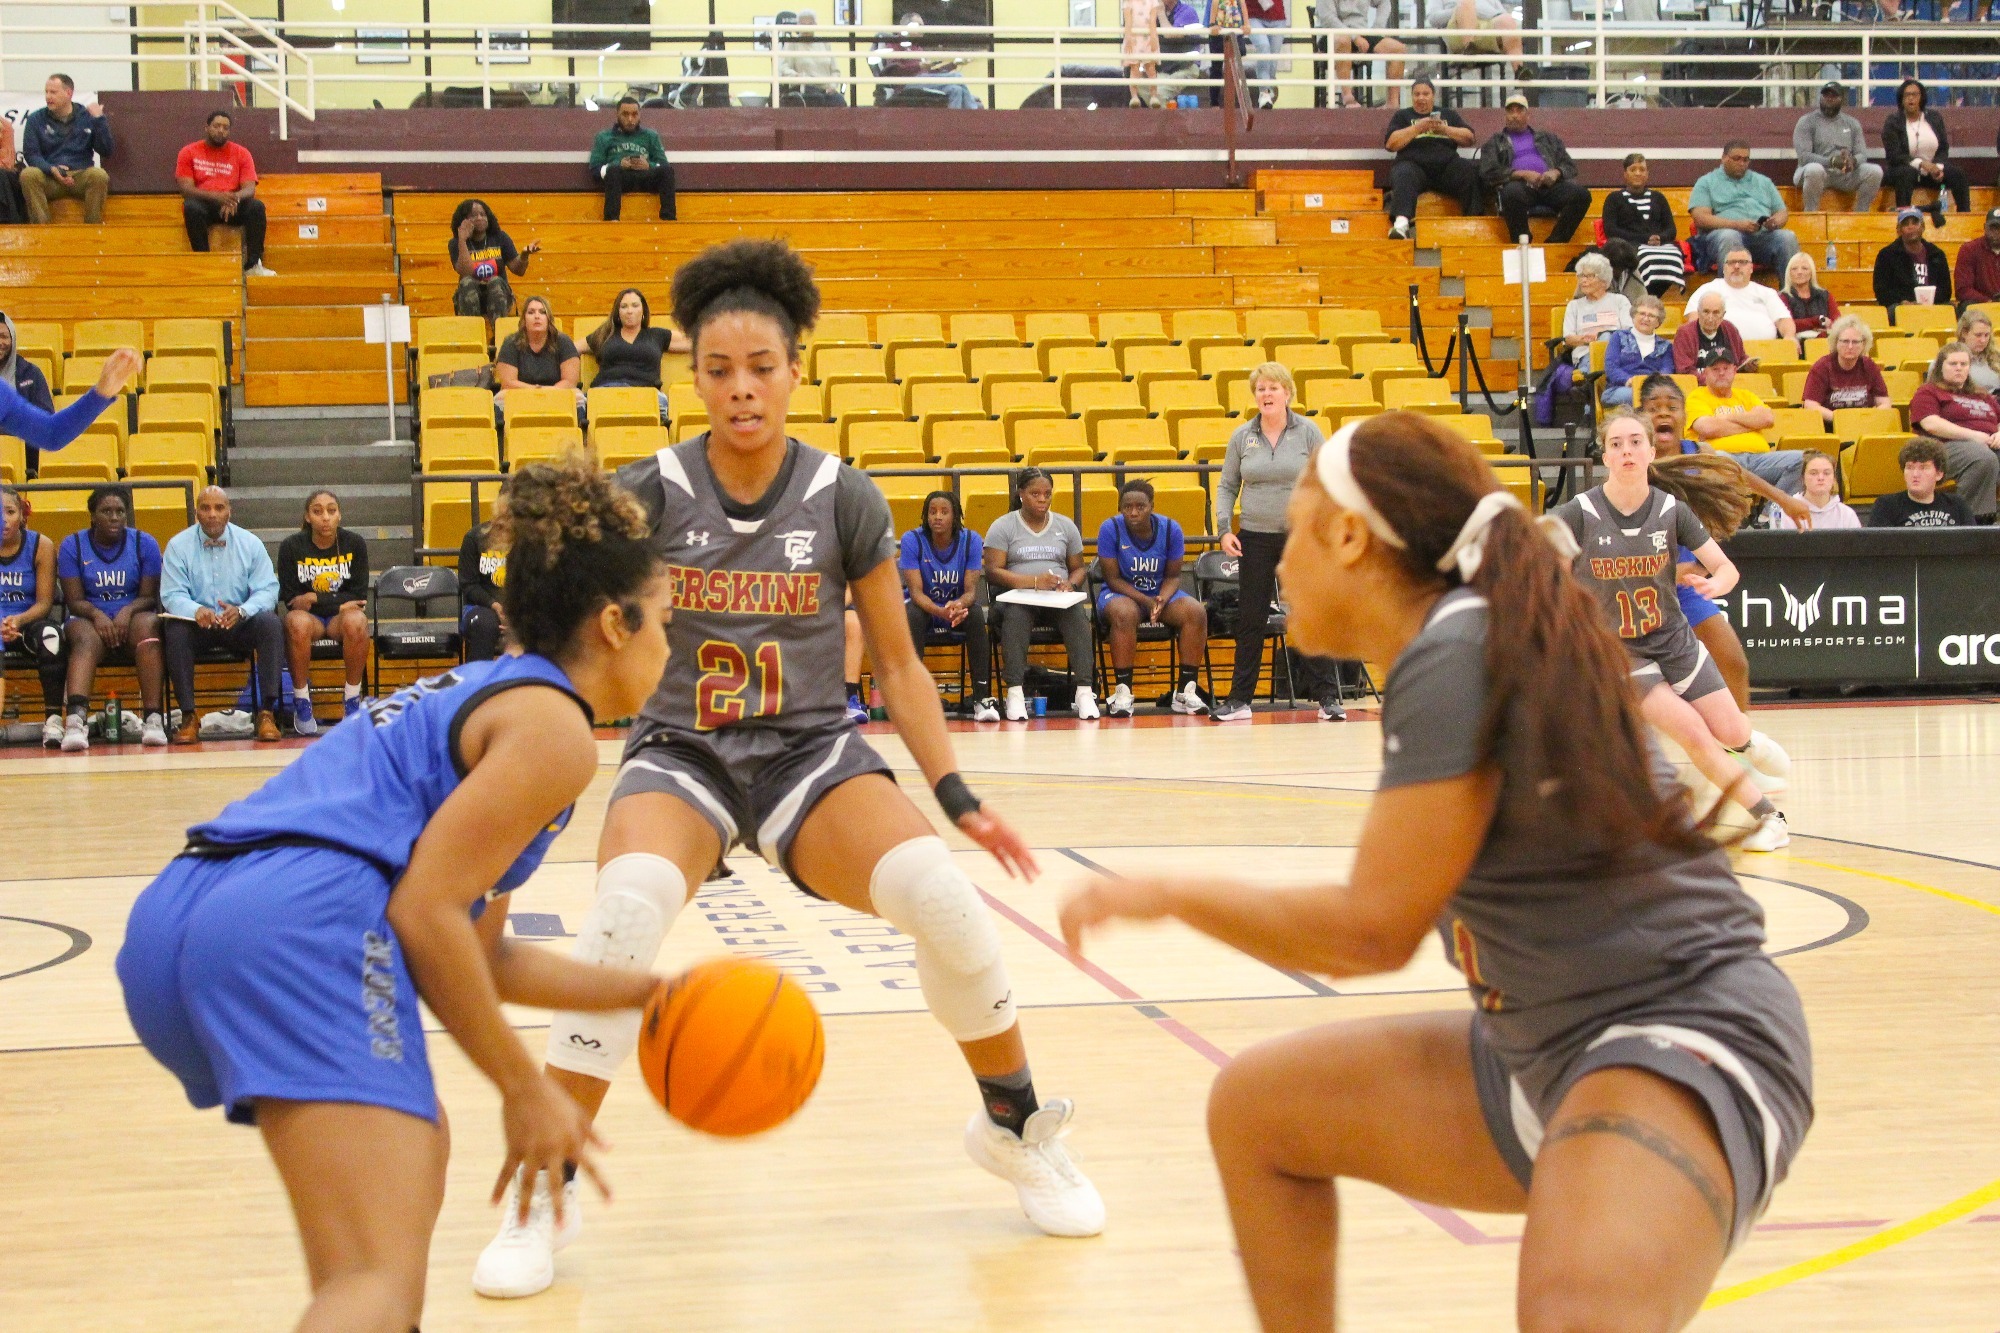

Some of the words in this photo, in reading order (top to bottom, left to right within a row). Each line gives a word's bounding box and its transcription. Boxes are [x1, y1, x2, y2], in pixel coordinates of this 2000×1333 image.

[1908, 510, 1951, 523] HELLFIRE
[1920, 518, 1942, 527] CLUB
[1130, 556, 1159, 573] JWU
[0, 571, 23, 586] WU
[95, 570, 126, 588] JWU
[931, 570, 959, 584] JWU
[1616, 586, 1662, 638] 13
[401, 636, 436, 645] ERSKINE
[694, 640, 783, 731] 21
